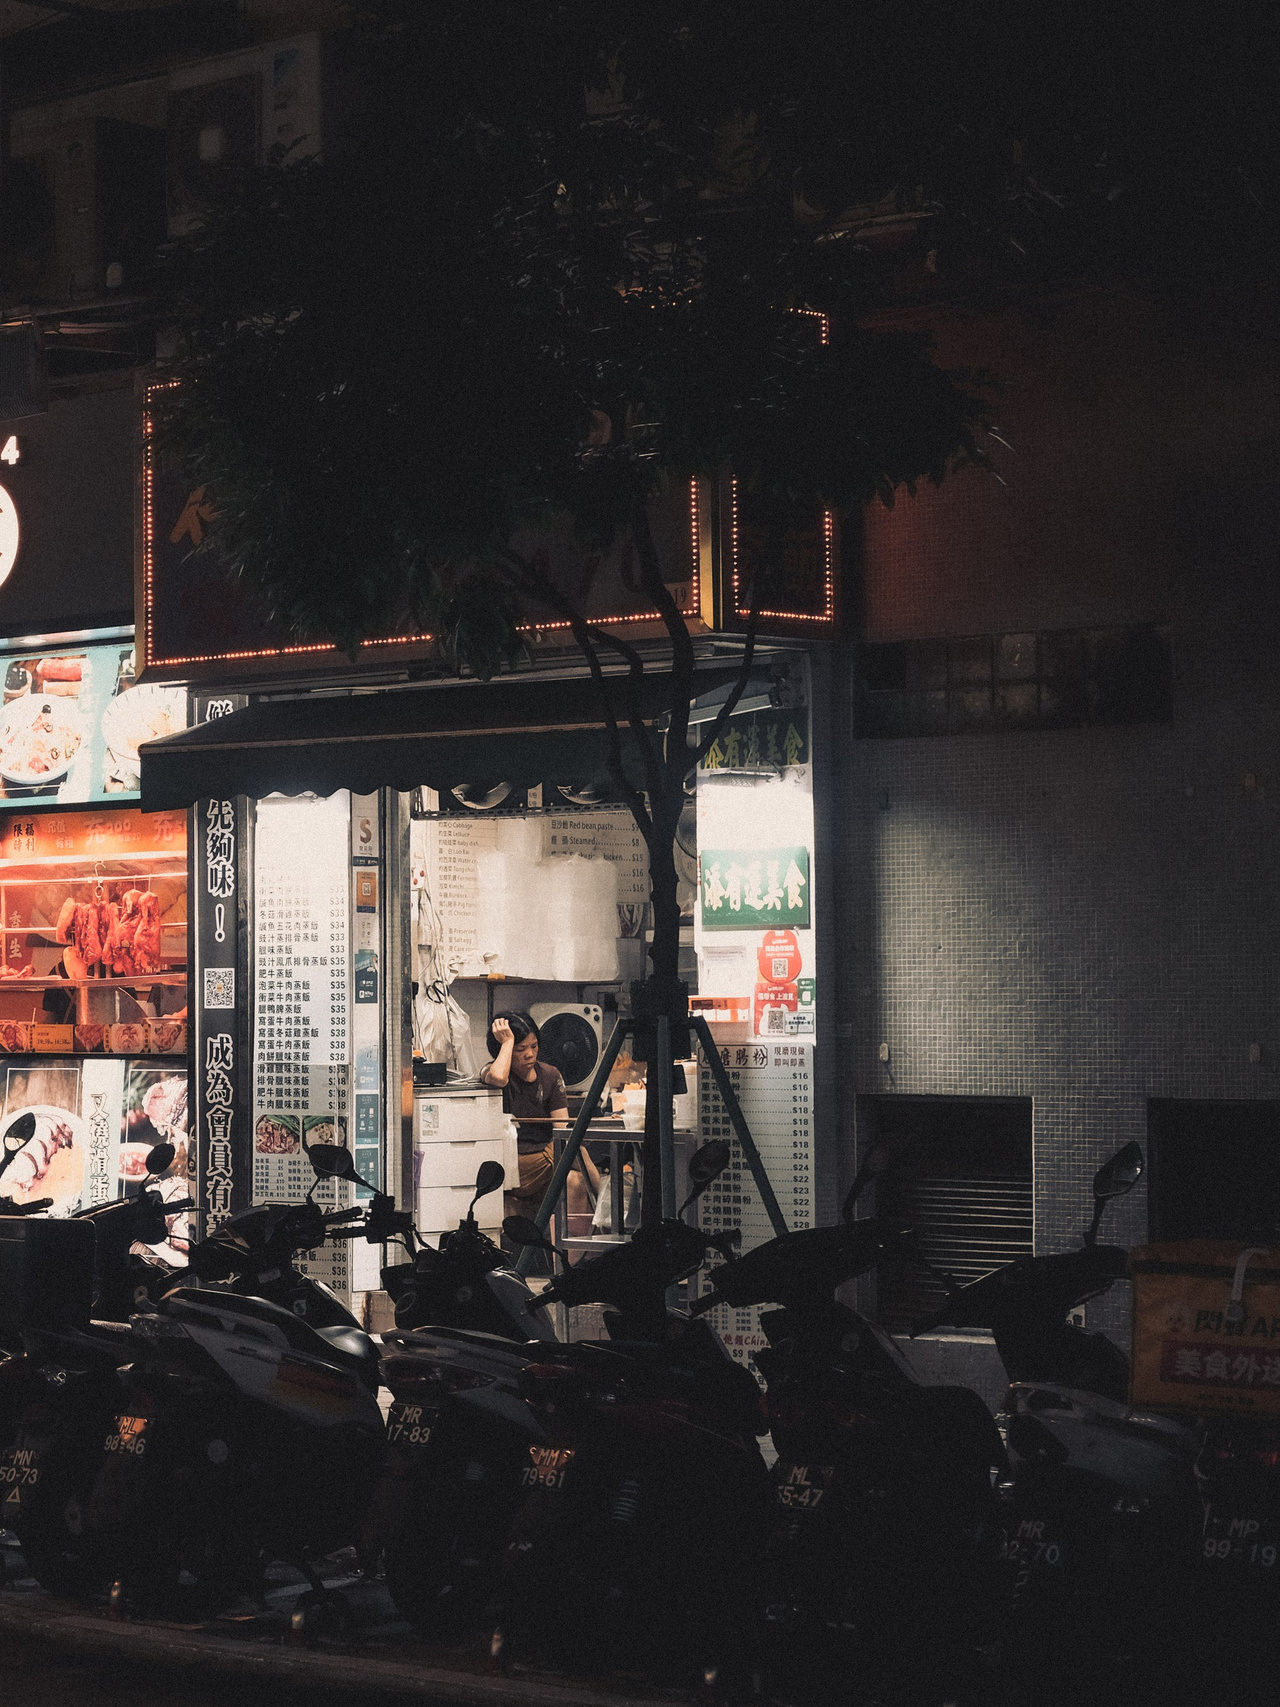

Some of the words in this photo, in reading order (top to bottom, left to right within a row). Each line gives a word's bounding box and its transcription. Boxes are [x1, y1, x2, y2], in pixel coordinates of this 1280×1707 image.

[569, 820, 580, 829] Red
[581, 820, 596, 830] bean
[597, 822, 614, 831] paste
[569, 836, 596, 845] Steamed
[631, 838, 640, 847] $8
[602, 852, 623, 861] hicken
[631, 853, 644, 862] $15
[632, 868, 644, 877] $16
[632, 883, 645, 893] $16
[329, 921, 345, 931] $34
[329, 933, 345, 942] $33
[330, 945, 345, 955] $33
[330, 957, 346, 967] $35
[259, 969, 293, 979] 肥牛蒸飯
[330, 969, 346, 979] $35
[259, 981, 310, 990] 泡菜牛肉蒸飯
[330, 981, 346, 990] $35
[330, 993, 346, 1002] $35
[330, 1004, 346, 1014] $35
[330, 1016, 346, 1026] $38
[330, 1028, 346, 1038] $38
[330, 1040, 346, 1050] $38
[329, 1052, 345, 1061] $38
[792, 1073, 808, 1081] $16
[792, 1084, 808, 1092] $16
[792, 1095, 808, 1103] $18
[792, 1107, 808, 1115] $18
[792, 1118, 808, 1126] $18
[793, 1129, 809, 1137] $18
[793, 1141, 809, 1149] $18
[793, 1153, 809, 1161] $24
[793, 1164, 809, 1172] $24
[793, 1174, 809, 1182] $22
[793, 1185, 809, 1195] $23
[793, 1196, 809, 1206] $22
[793, 1208, 809, 1218] $22
[794, 1219, 810, 1229] $28
[332, 1240, 347, 1248] $36
[332, 1253, 347, 1262] $36
[332, 1266, 347, 1275] $36
[332, 1280, 347, 1289] $36
[400, 1405, 423, 1424] MR
[387, 1424, 431, 1444] 17-83
[103, 1434, 146, 1456] 98-46
[13, 1449, 34, 1466] MN
[539, 1448, 560, 1467] MM
[521, 1467, 566, 1489] 79-61
[787, 1466, 812, 1485] ML
[1018, 1520, 1046, 1540] MR
[1228, 1518, 1260, 1539] MP
